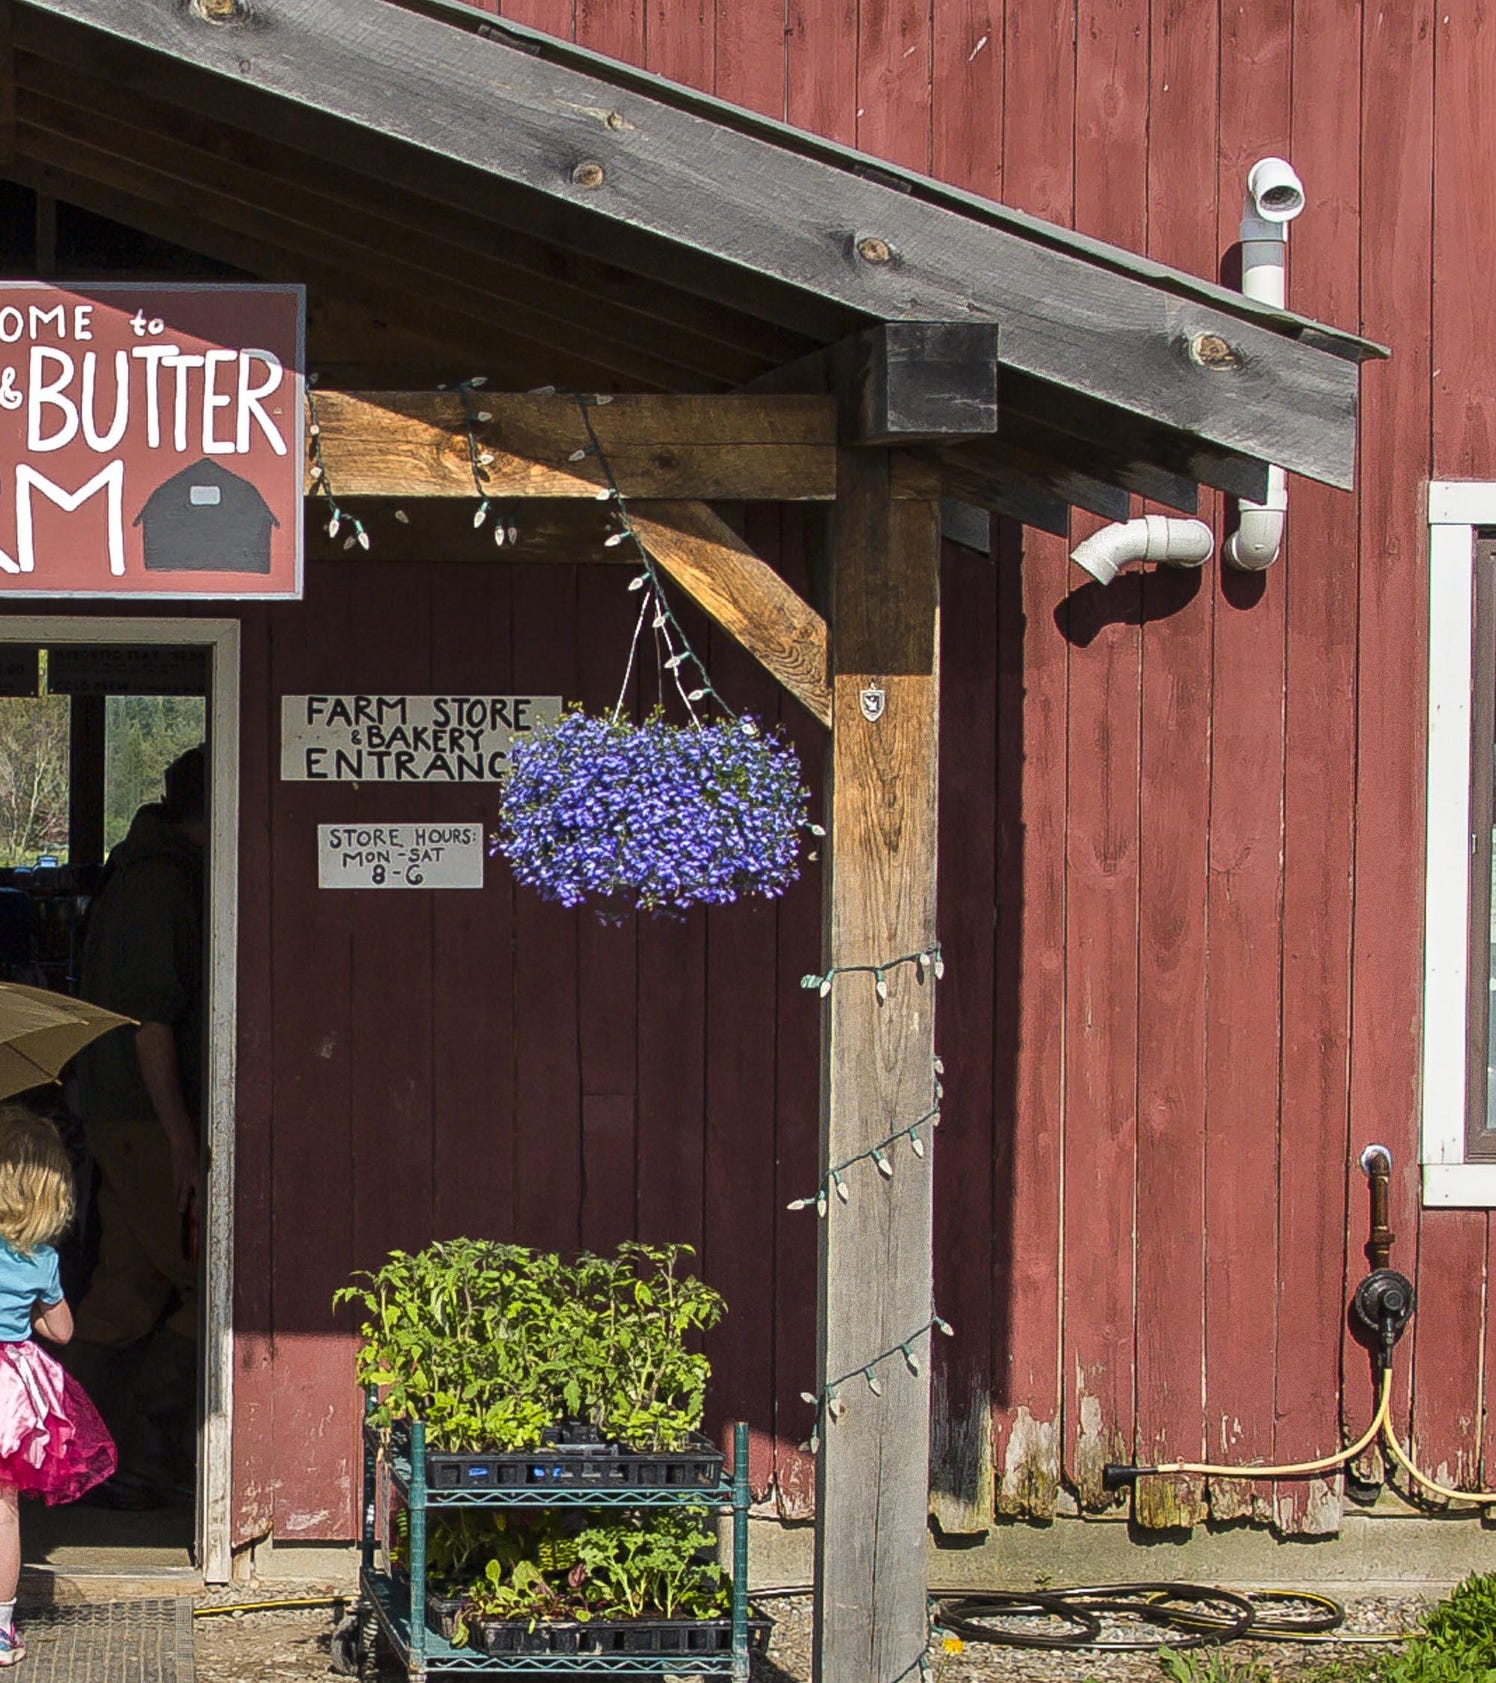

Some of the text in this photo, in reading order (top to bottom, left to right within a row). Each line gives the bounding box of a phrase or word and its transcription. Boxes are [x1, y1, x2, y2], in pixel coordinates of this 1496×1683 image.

[129, 307, 165, 337] to
[26, 345, 289, 457] BUTTER
[306, 695, 533, 732] FARM STORE
[350, 725, 485, 755] & BAKERY
[305, 747, 508, 781] ENTRANC
[329, 827, 478, 849] STORE HOURS:
